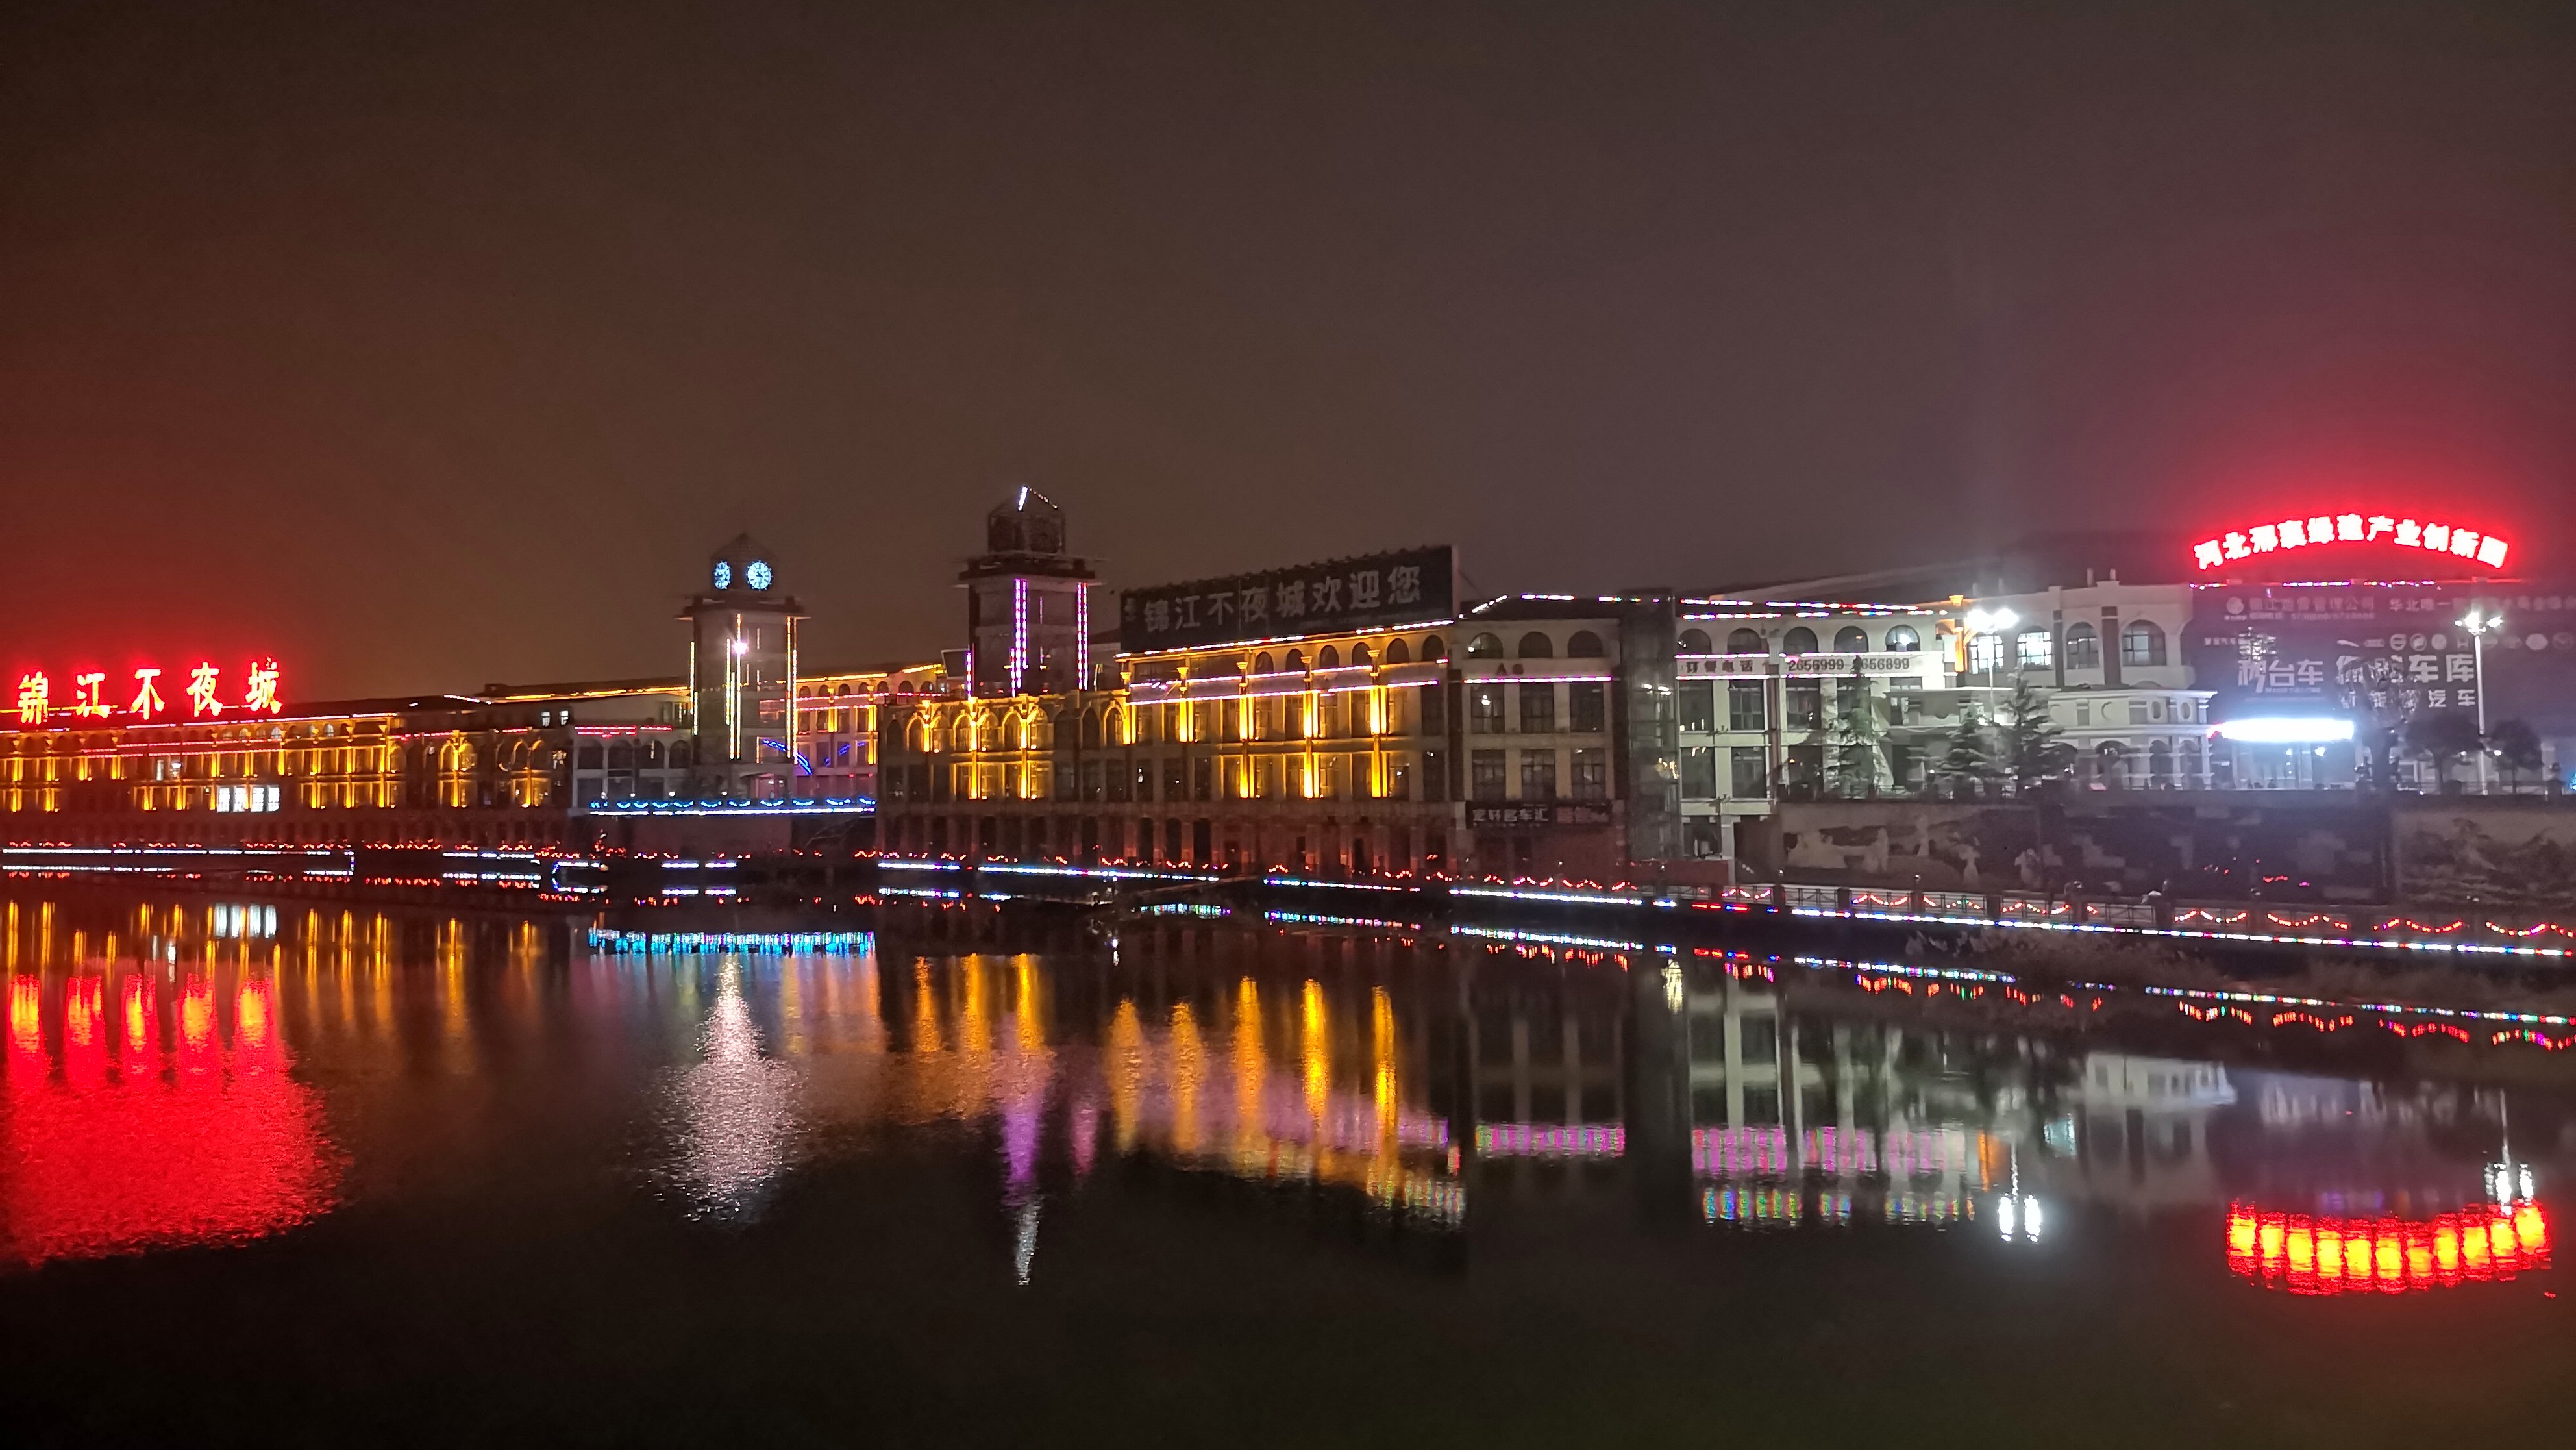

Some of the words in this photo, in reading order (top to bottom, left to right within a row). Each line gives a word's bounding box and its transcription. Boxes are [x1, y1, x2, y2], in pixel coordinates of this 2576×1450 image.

[1144, 566, 1421, 632] 锦江不夜城欢迎您
[18, 656, 283, 725] 锦江不夜城
[1854, 658, 1910, 670] 656899
